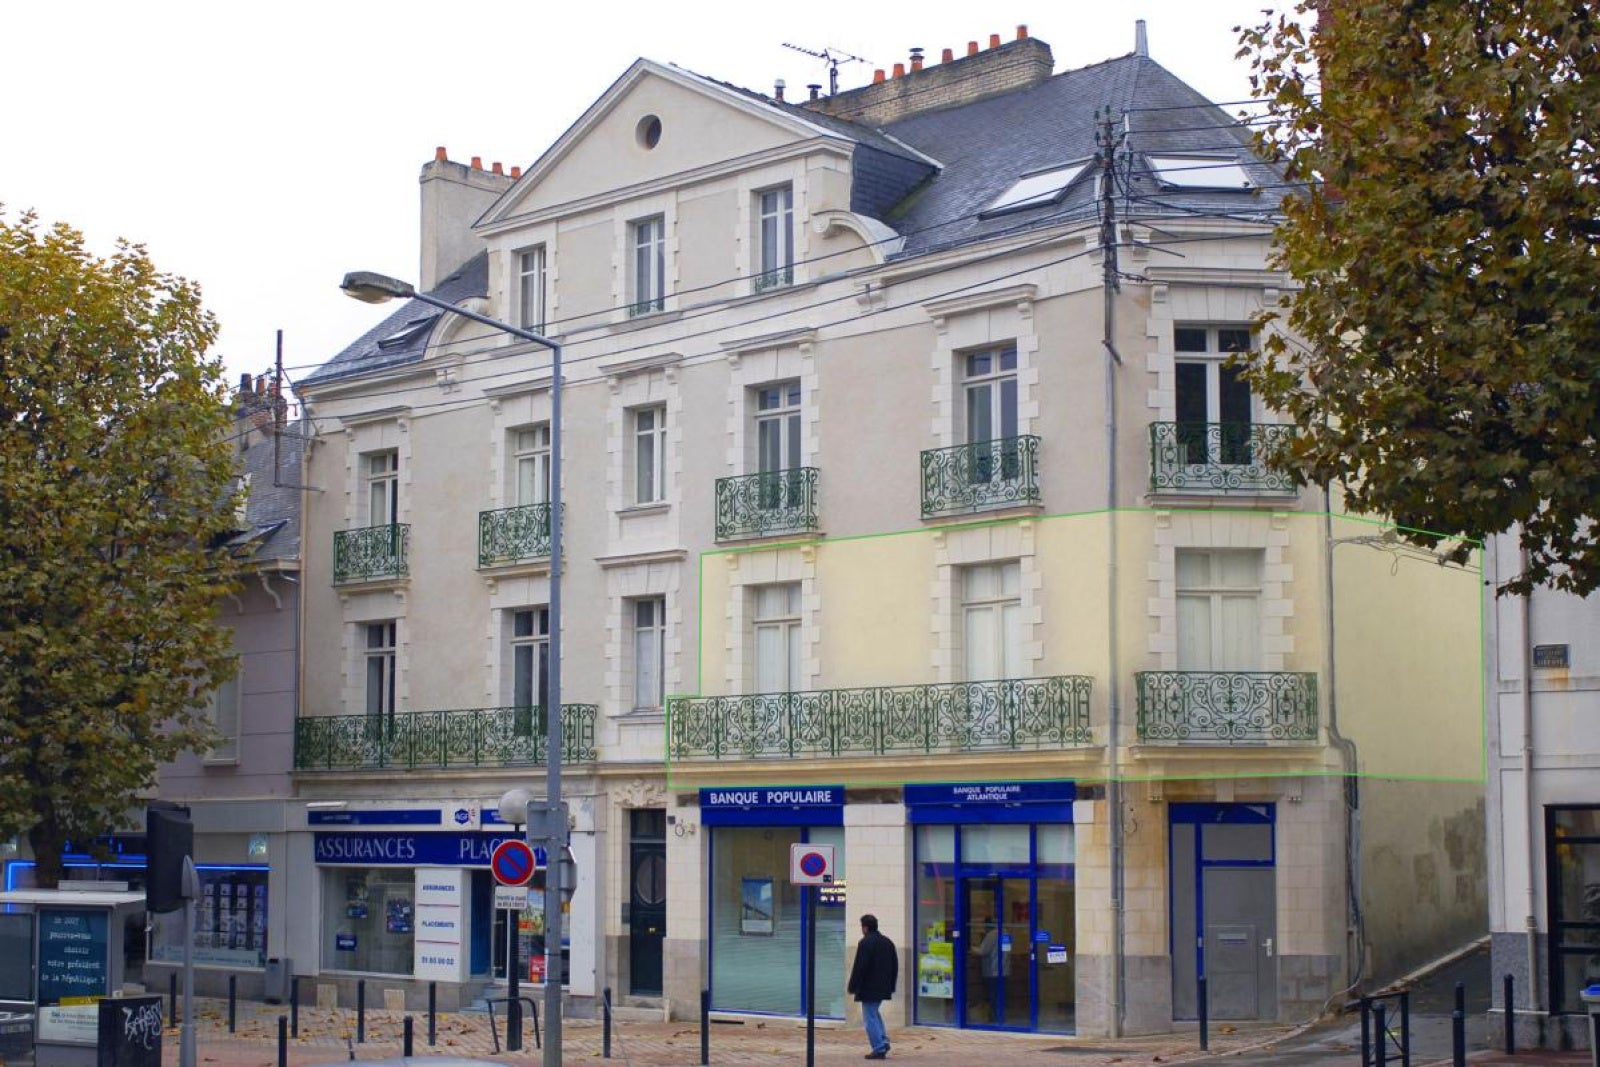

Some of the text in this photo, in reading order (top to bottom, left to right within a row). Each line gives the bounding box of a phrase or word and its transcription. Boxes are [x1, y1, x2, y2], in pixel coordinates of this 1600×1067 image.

[953, 785, 1021, 794] BANQUE POPULAIRE
[709, 790, 832, 805] BANQUE POPULAIRE
[966, 793, 1008, 801] ATLANTIQUE
[316, 838, 416, 860] ASSURANCES
